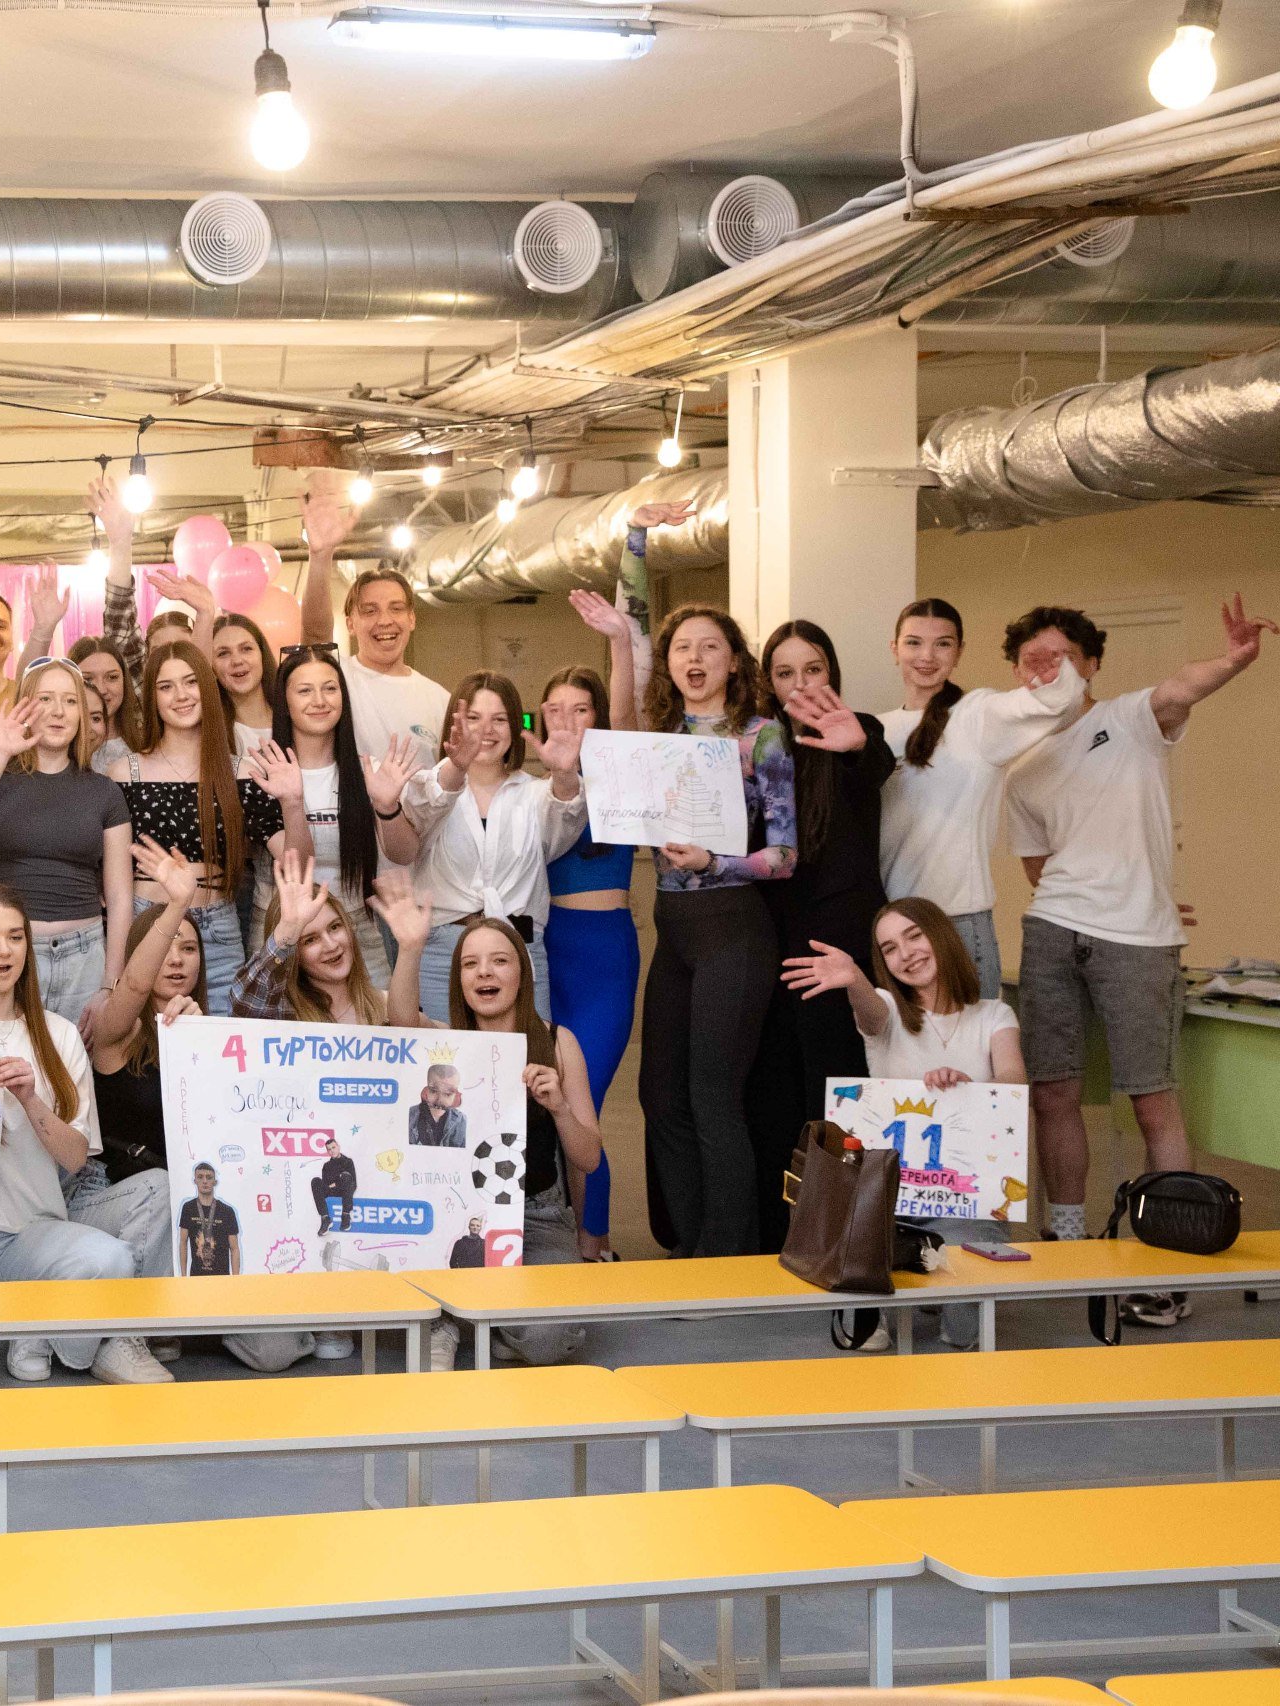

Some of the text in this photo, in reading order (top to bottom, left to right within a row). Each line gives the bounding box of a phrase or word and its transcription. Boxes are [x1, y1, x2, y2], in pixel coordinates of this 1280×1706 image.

[222, 1034, 247, 1073] 4
[322, 1083, 393, 1097] ЗВЕРХУ
[900, 1170, 956, 1186] ЕРЕМОГА
[914, 1188, 970, 1205] ЖИВУТЬ
